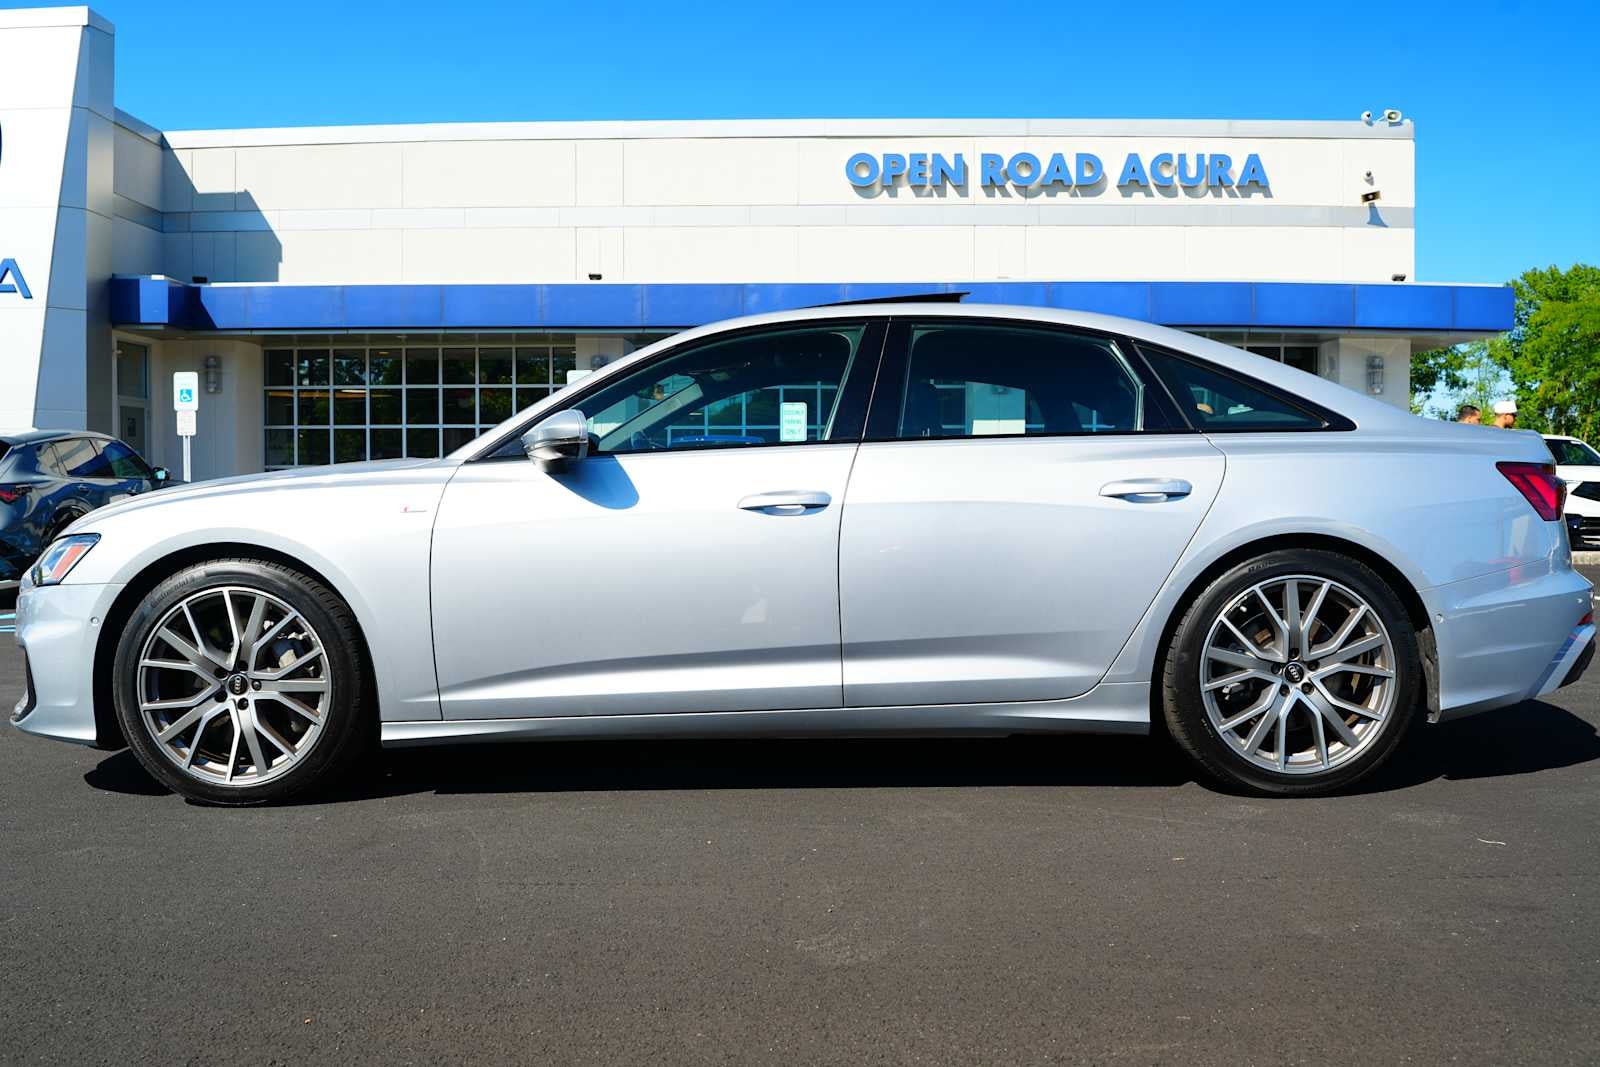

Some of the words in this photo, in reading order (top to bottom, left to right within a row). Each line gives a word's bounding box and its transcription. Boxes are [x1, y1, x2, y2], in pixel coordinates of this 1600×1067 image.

[845, 152, 964, 186] OPEN
[981, 152, 1104, 186] ROAD
[1118, 152, 1270, 186] ACURA
